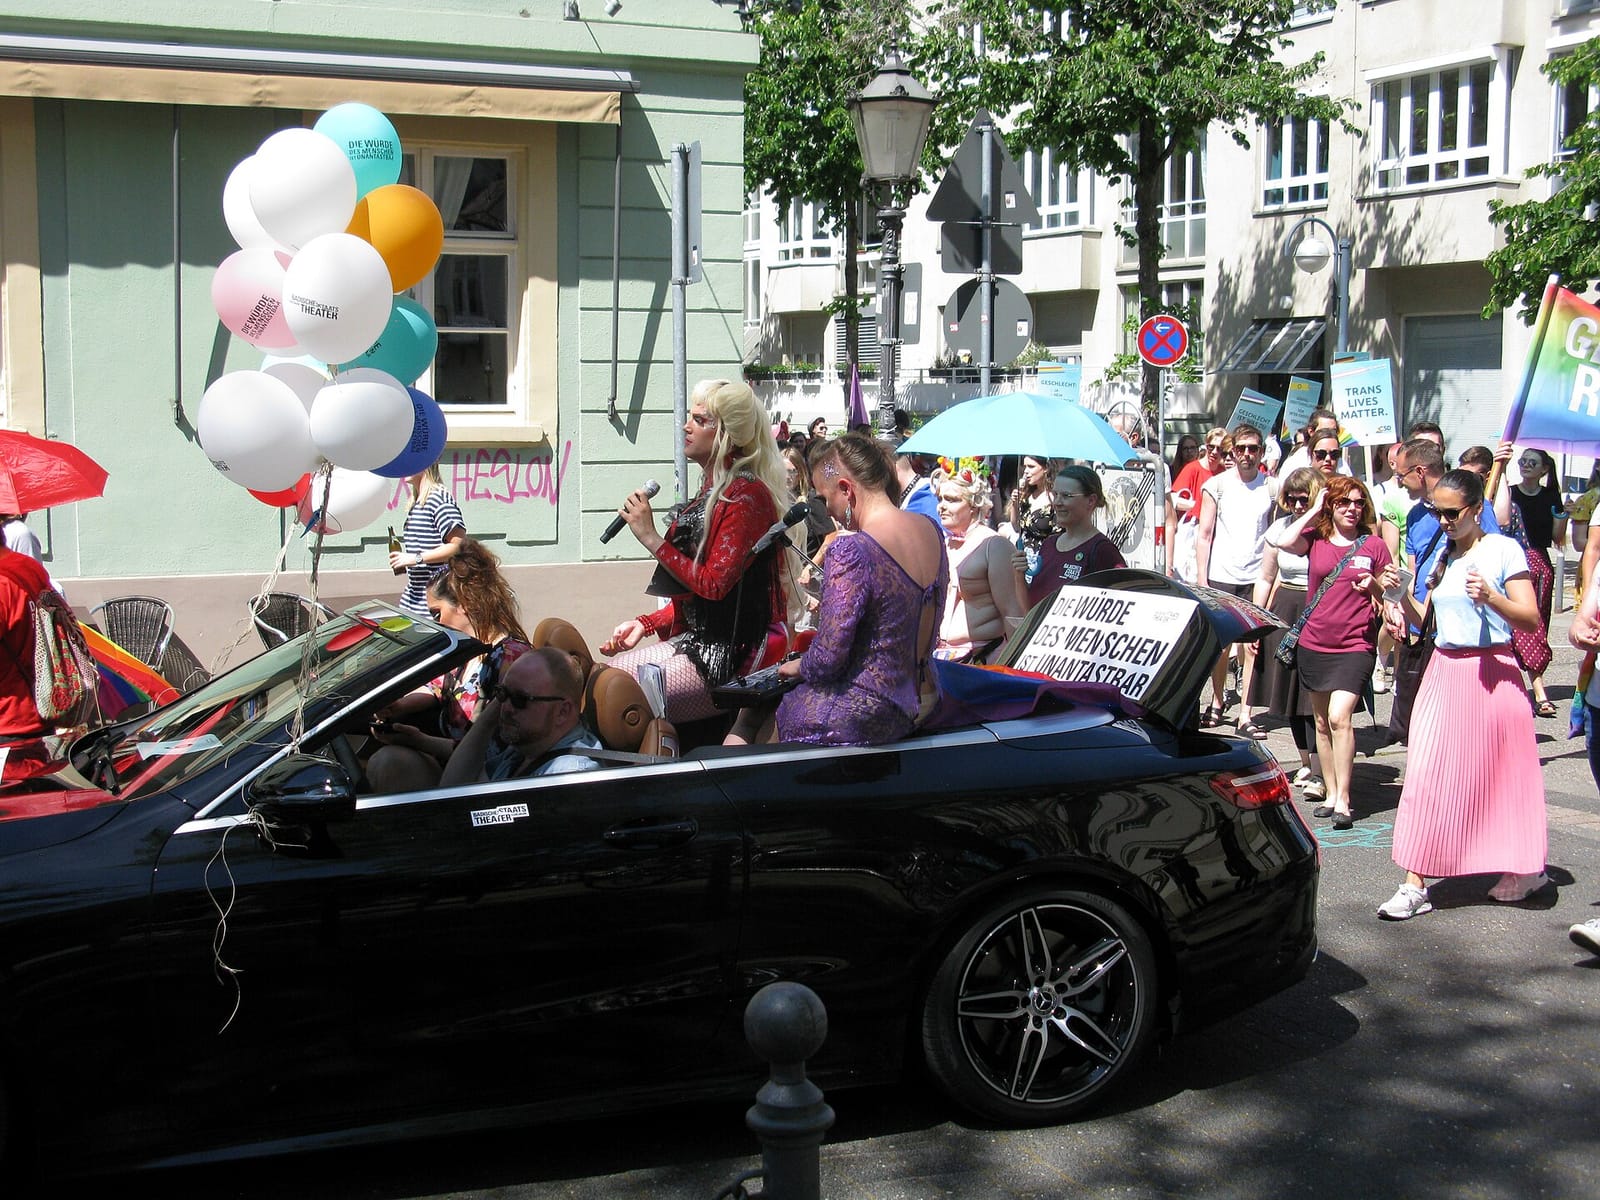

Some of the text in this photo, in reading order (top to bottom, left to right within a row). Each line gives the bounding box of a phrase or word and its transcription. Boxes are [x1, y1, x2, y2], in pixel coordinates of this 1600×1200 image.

[348, 140, 363, 149] DIE
[300, 304, 338, 320] THEATER
[241, 322, 253, 334] DIE
[1345, 385, 1382, 397] TRANS
[1348, 396, 1379, 408] LIVES
[1340, 408, 1388, 420] MATTER.
[1052, 597, 1076, 617] DIE
[1072, 591, 1135, 626] WÜRDE
[1032, 624, 1169, 667] DES MENSCHEN
[1016, 654, 1037, 672] IST
[498, 805, 527, 814] STAATS
[474, 814, 512, 825] THEATER
